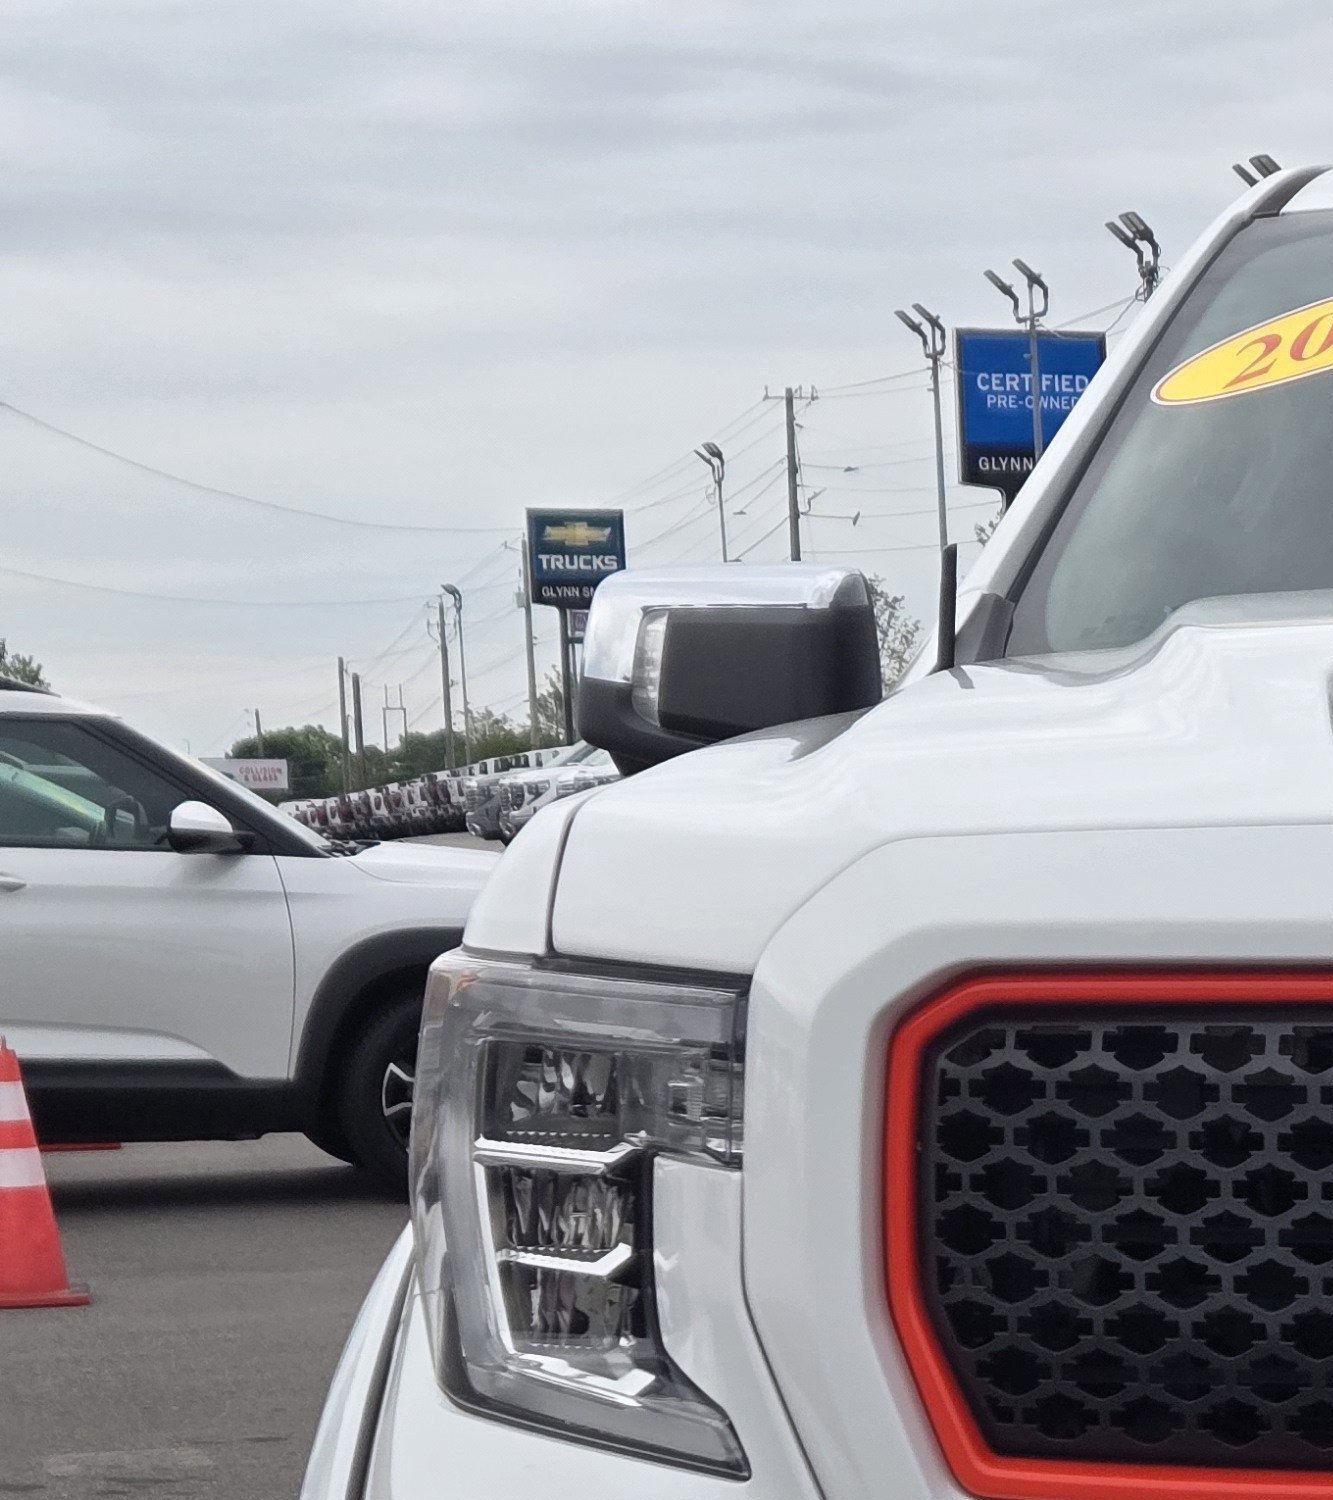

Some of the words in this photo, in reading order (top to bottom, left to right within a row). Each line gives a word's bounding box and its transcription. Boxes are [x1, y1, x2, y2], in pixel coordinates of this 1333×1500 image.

[976, 373, 1089, 392] CERTFIED
[978, 456, 1033, 471] GLYNN
[538, 554, 618, 571] TRUCKS
[542, 586, 579, 598] GLYNN
